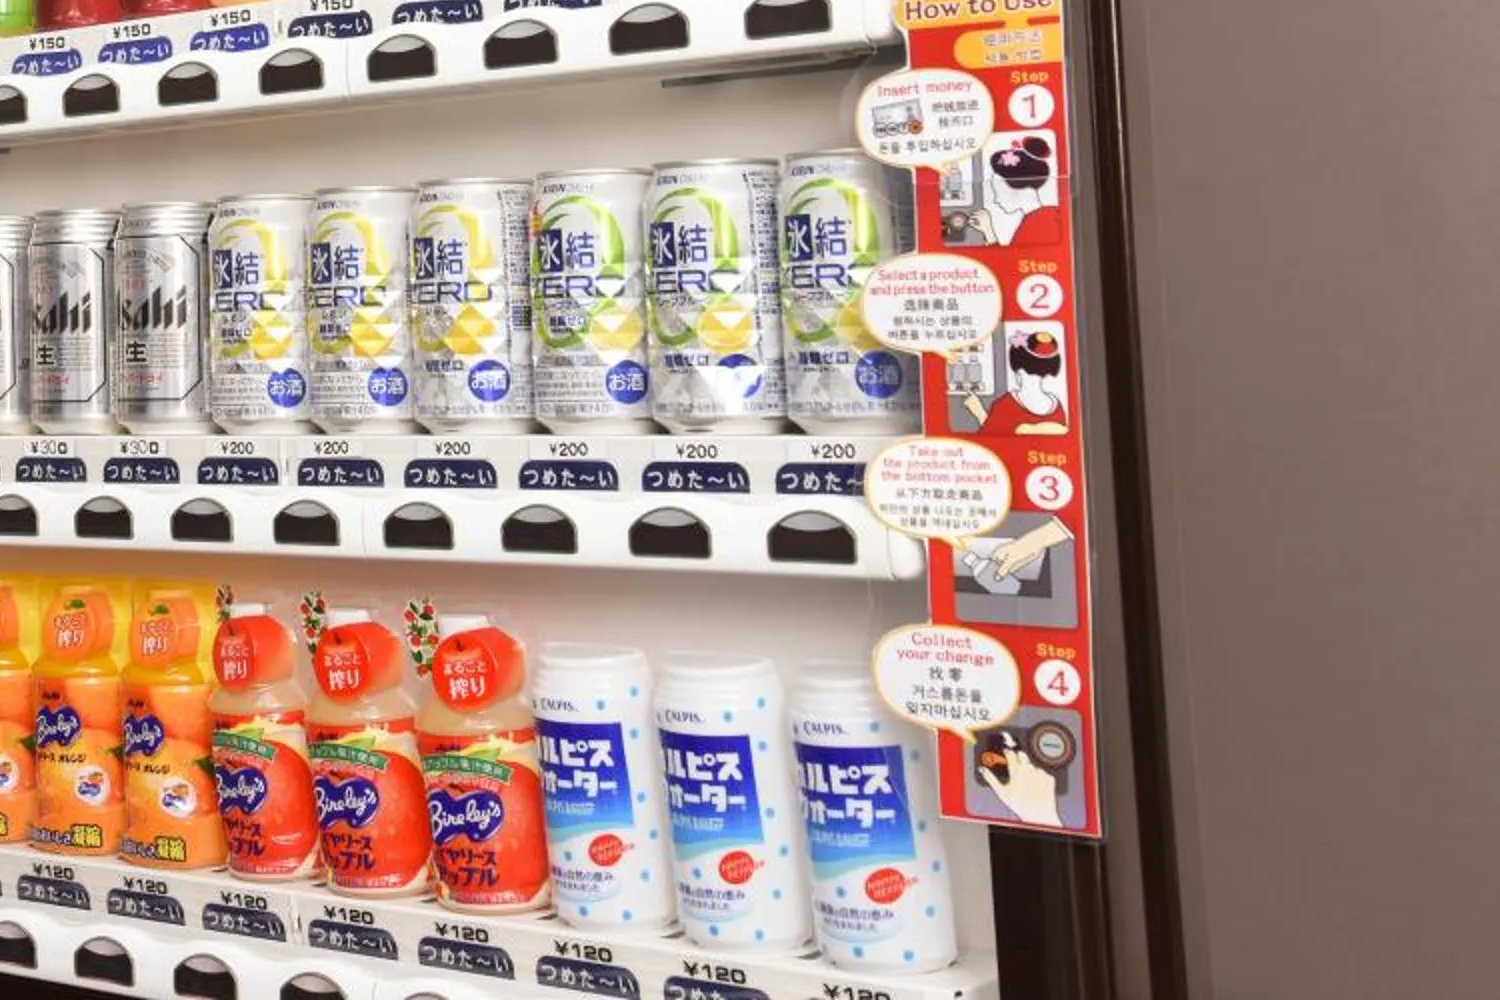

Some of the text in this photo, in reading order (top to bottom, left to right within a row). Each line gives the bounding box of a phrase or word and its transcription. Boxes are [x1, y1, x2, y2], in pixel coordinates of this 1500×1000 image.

[210, 10, 251, 26] ¥150
[905, 1, 960, 21] How
[112, 23, 151, 38] ¥150
[29, 37, 66, 51] ¥150
[1011, 71, 1049, 84] Step
[877, 81, 972, 97] Insert money
[1023, 93, 1036, 118] 1
[652, 222, 709, 265] 氷結
[785, 215, 848, 260] 氷結
[414, 238, 463, 279] 氷結
[539, 230, 595, 271] 氷結
[311, 243, 360, 284] 氷結
[1018, 260, 1057, 274] Step
[878, 269, 917, 281] Select
[929, 268, 979, 282] product
[412, 281, 492, 302] ERO
[870, 283, 996, 296] and press the button
[1029, 283, 1049, 309] 2
[609, 373, 645, 392] お酒
[221, 441, 255, 455] ¥200
[314, 441, 349, 455] ¥200
[435, 442, 472, 456] ¥200
[550, 443, 589, 458] ¥200
[675, 443, 718, 460] ¥200
[810, 444, 856, 460] ¥200
[883, 457, 990, 470] the product from
[1028, 451, 1066, 466] Step
[781, 471, 866, 492] つめた〜
[881, 471, 997, 484] the bottom pocket
[1038, 475, 1060, 501] 3
[911, 633, 972, 648] Collect
[896, 649, 994, 666] your change
[1036, 643, 1076, 659] Step
[1048, 670, 1069, 696] 4
[664, 748, 743, 781] ルピス
[799, 761, 892, 795] ルピス
[428, 799, 501, 840] Bireley's
[123, 876, 168, 895] ¥120
[220, 890, 267, 911] ¥120
[323, 905, 374, 926] ¥120
[436, 921, 489, 943] ¥120
[554, 940, 613, 963] ¥120
[683, 960, 746, 985] ¥120
